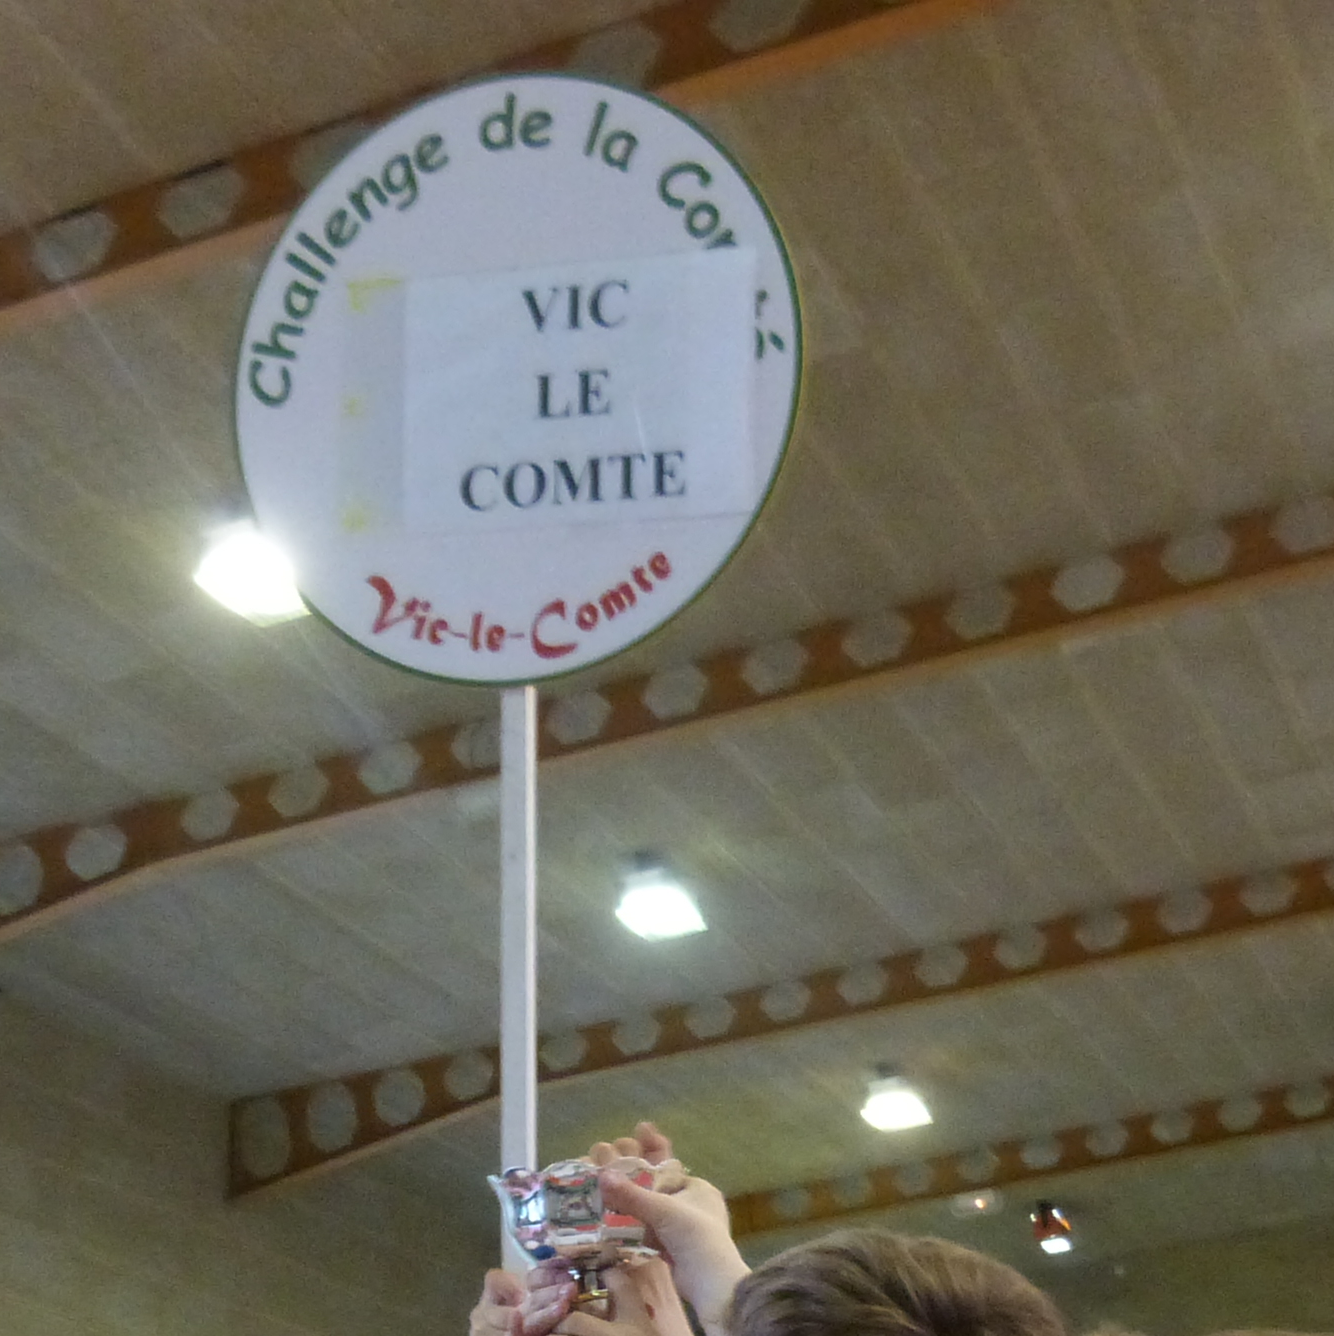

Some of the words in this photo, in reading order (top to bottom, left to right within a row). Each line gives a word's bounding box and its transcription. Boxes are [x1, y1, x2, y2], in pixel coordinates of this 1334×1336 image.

[248, 133, 450, 407] Challenge
[479, 92, 553, 151] de
[583, 101, 639, 173] la
[522, 279, 630, 333] VIC
[536, 369, 611, 419] LE
[460, 450, 687, 513] COMTE
